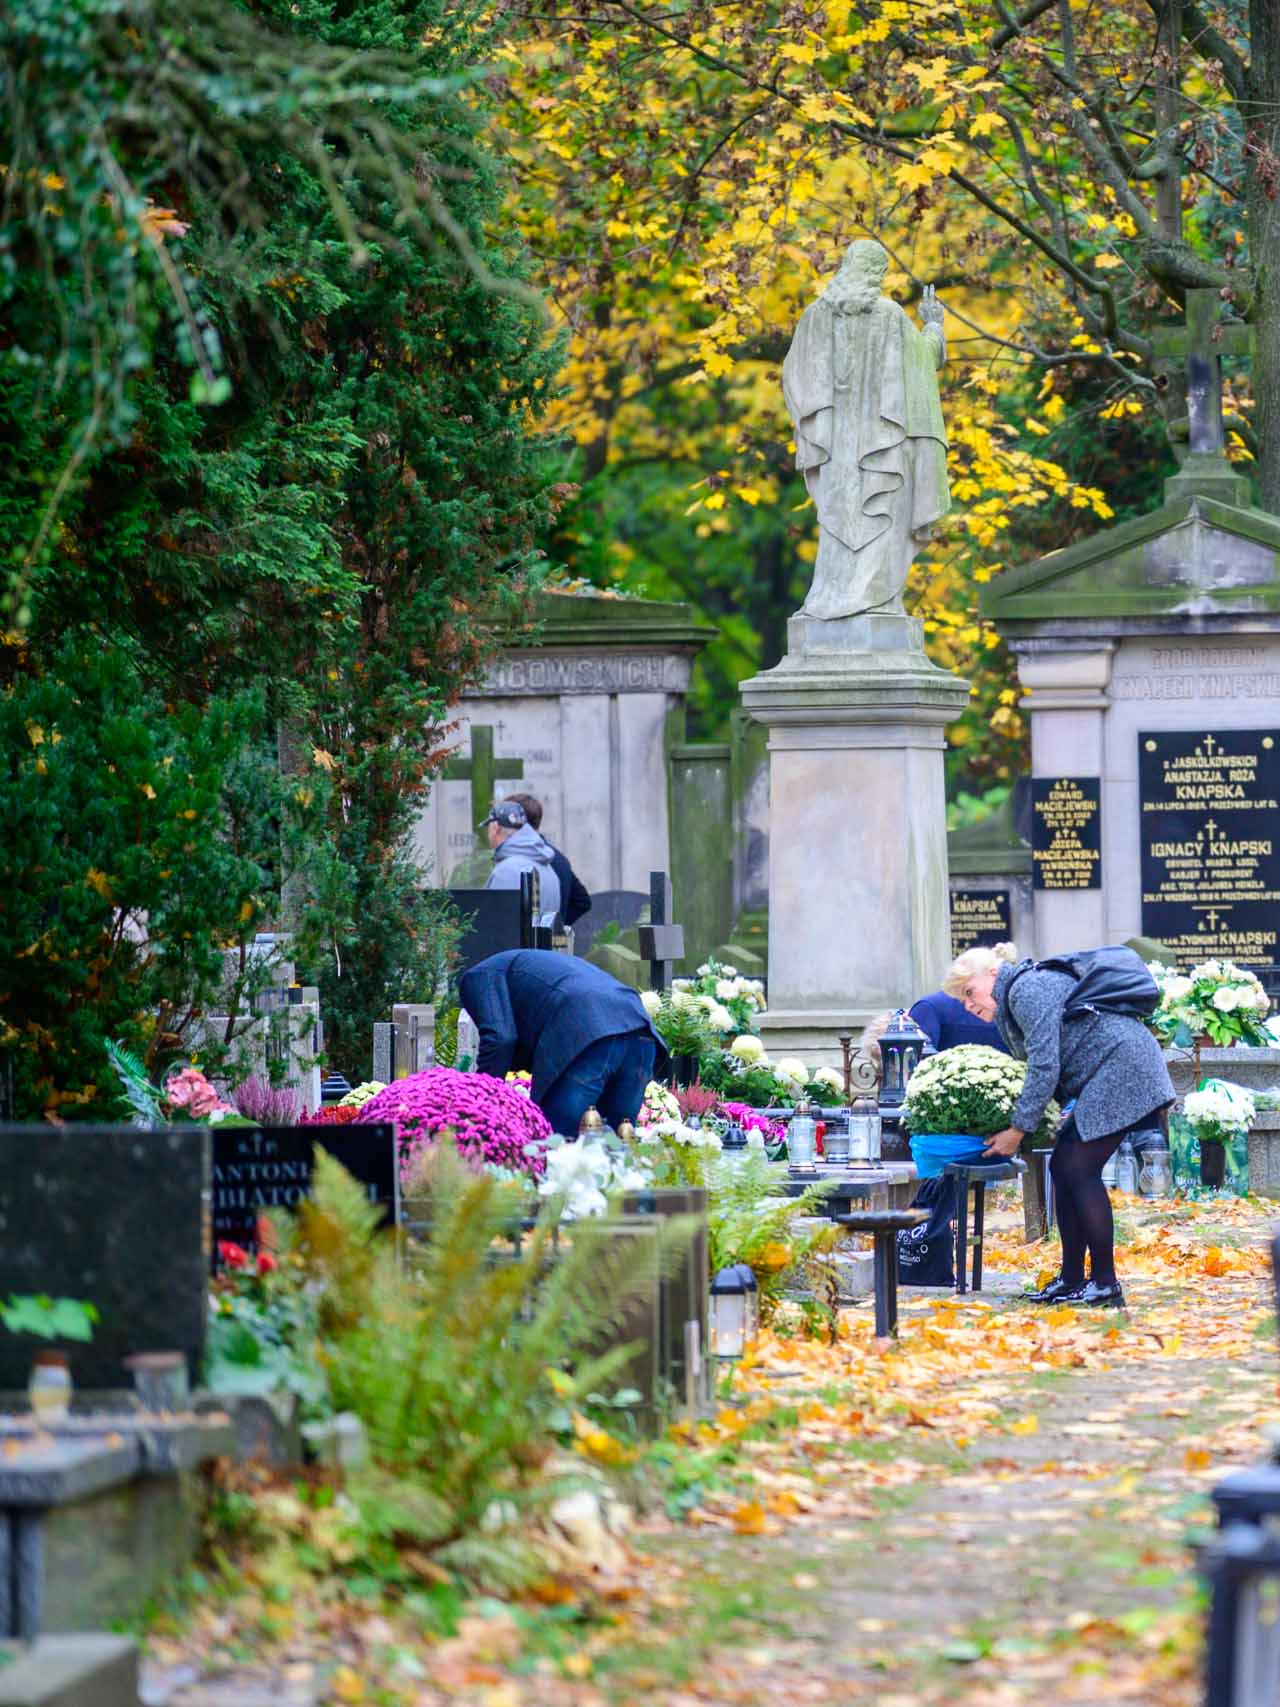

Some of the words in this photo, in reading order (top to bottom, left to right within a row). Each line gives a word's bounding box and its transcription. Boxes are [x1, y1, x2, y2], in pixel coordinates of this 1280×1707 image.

[1176, 784, 1245, 800] KNAPSKA
[1151, 842, 1203, 858] IGNACY
[1210, 840, 1272, 856] KNAPSKI
[953, 899, 998, 913] KNAPSKA
[1219, 931, 1277, 946] KNAPSKI
